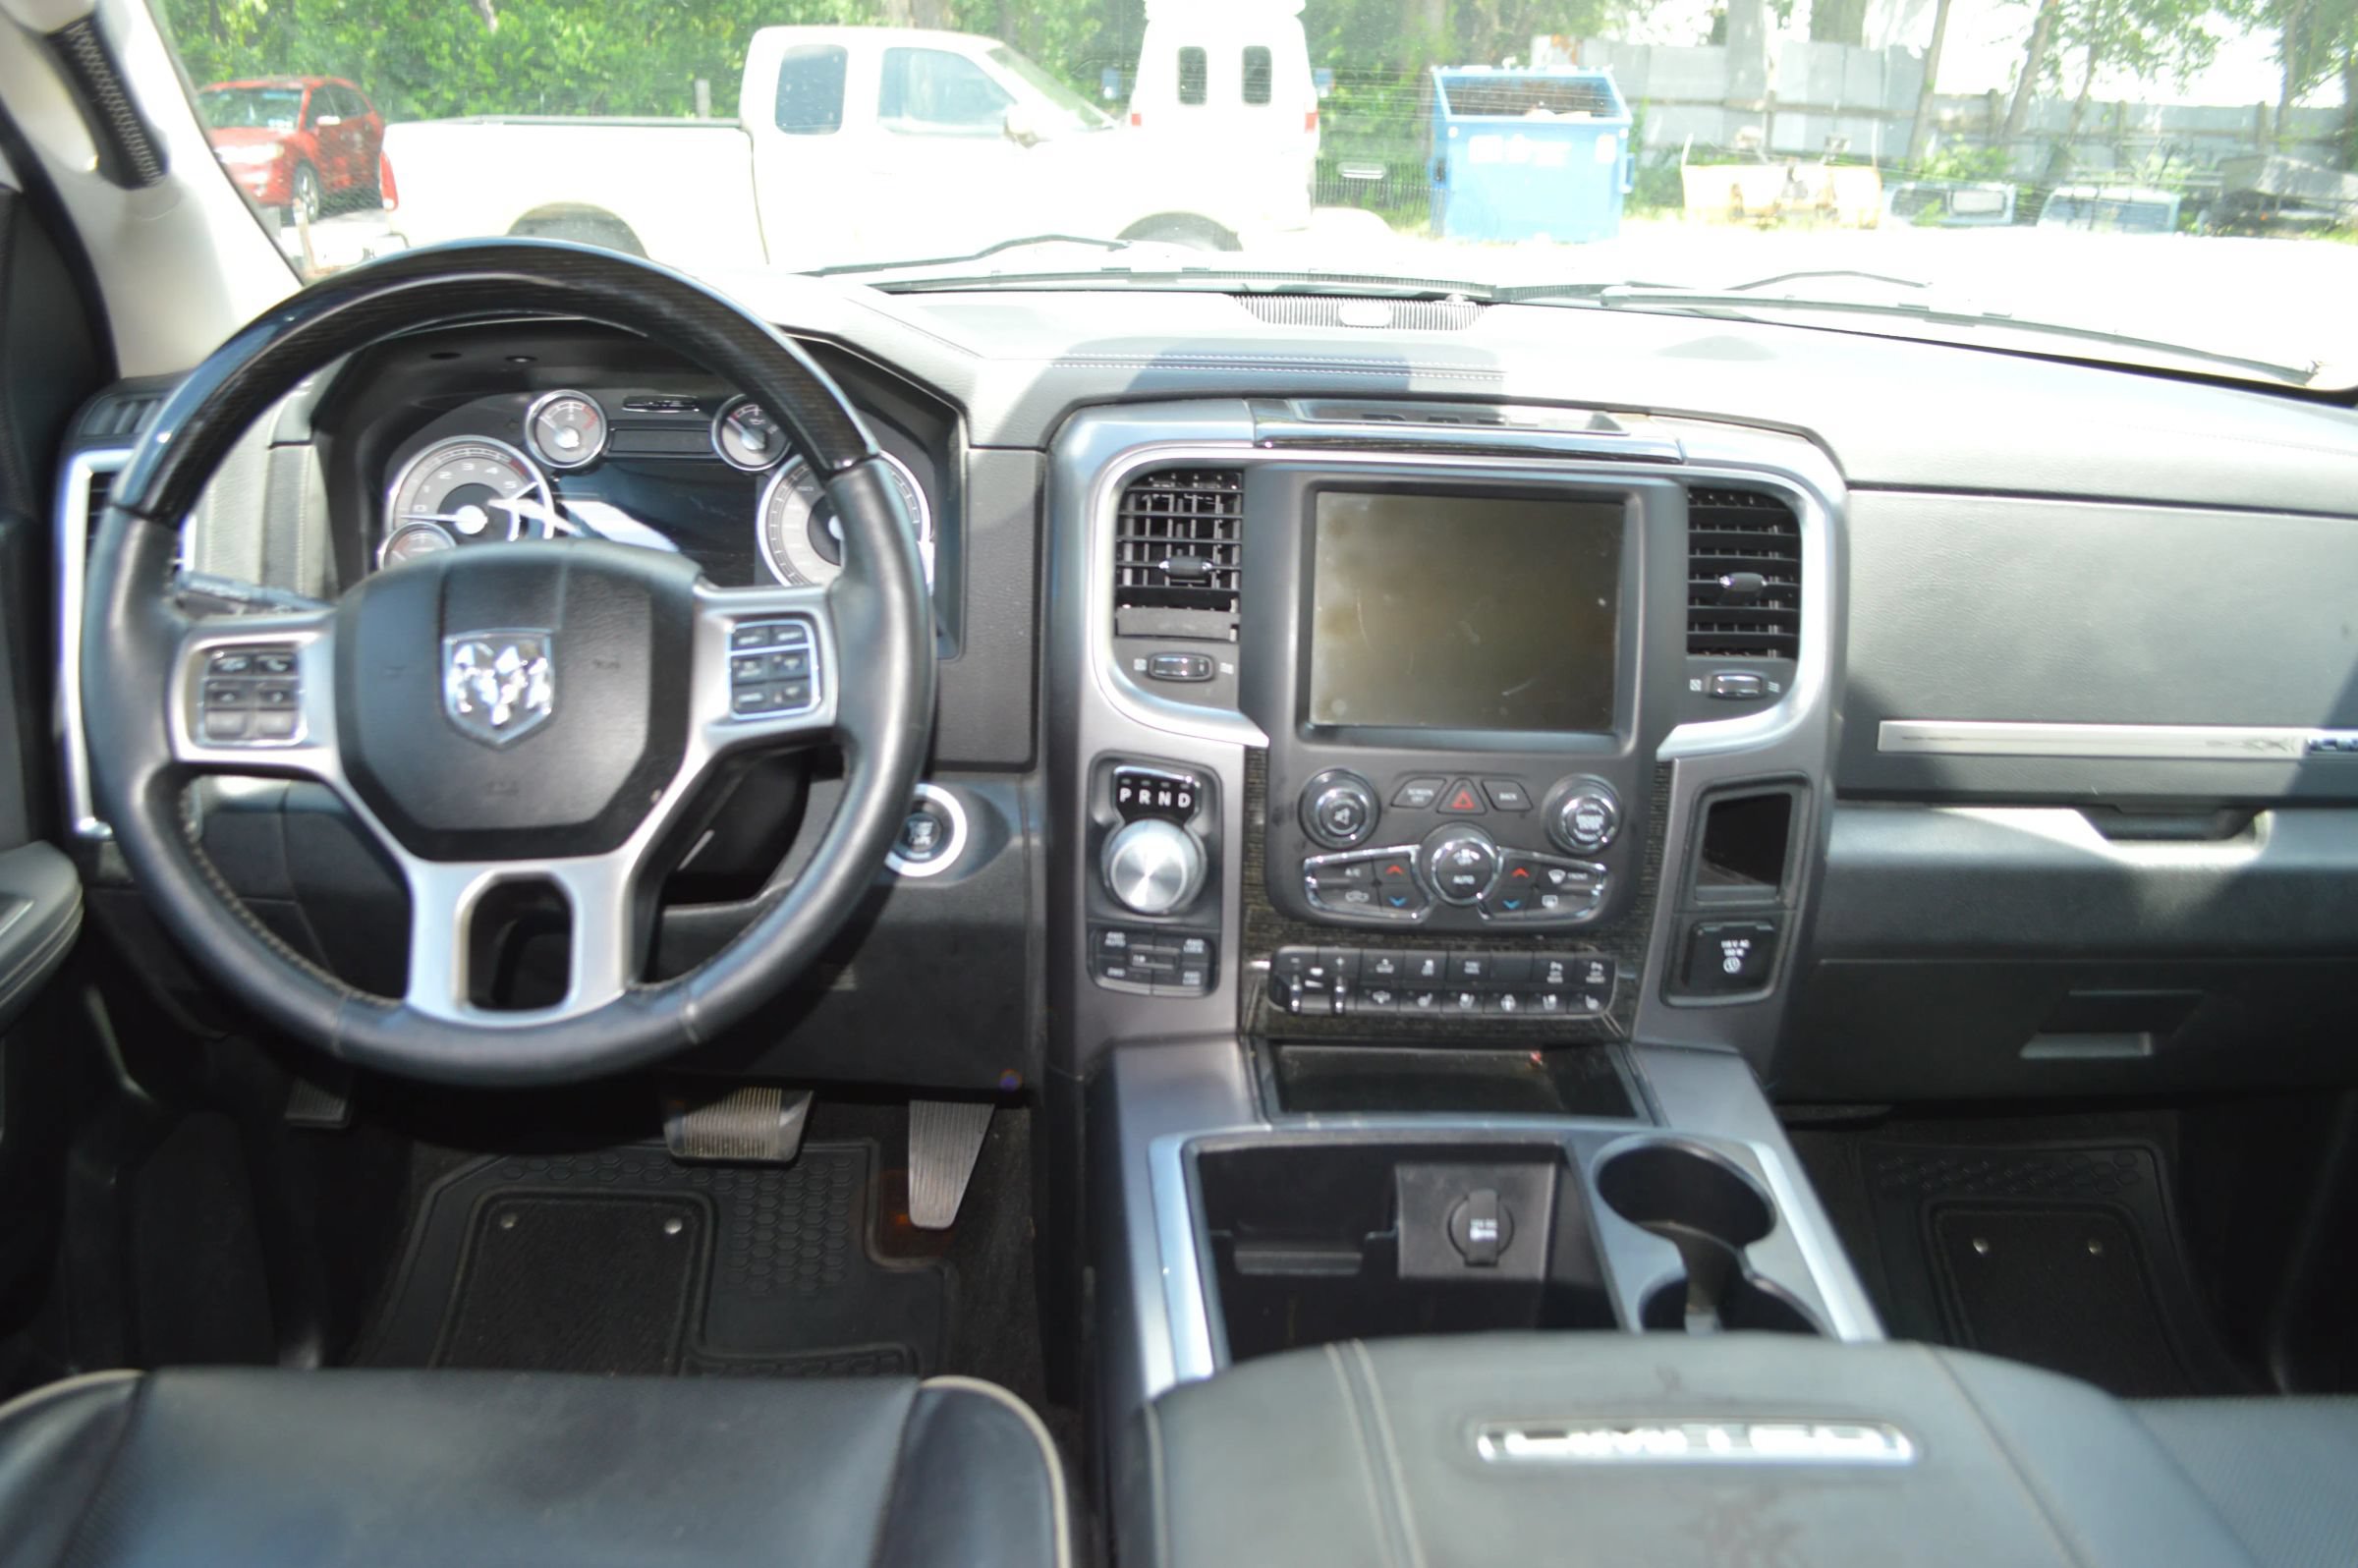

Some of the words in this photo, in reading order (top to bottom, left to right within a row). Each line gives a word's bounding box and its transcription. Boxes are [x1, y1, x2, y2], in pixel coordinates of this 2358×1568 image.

[438, 471, 453, 479] 2
[504, 480, 517, 489] 5
[414, 504, 426, 513] 0
[1119, 787, 1132, 803] P
[1139, 789, 1151, 805] R
[1158, 791, 1172, 807] N
[1178, 792, 1192, 808] D
[1498, 792, 1517, 801] BACK
[1452, 874, 1476, 884] AUTO
